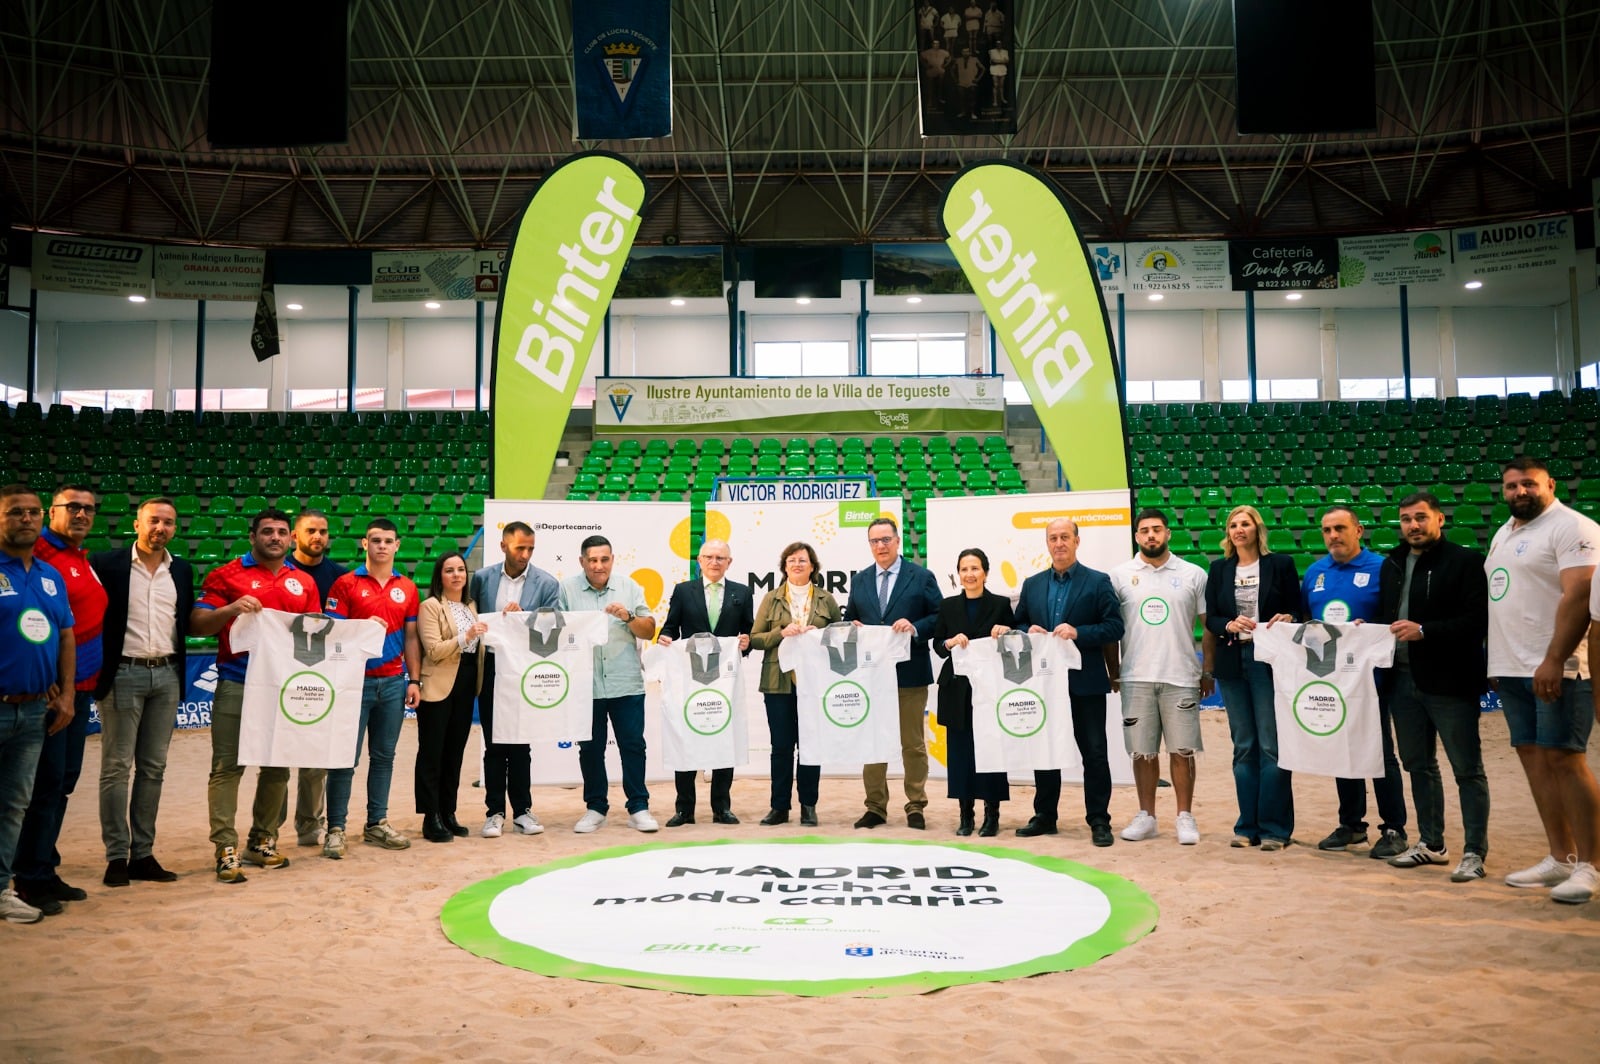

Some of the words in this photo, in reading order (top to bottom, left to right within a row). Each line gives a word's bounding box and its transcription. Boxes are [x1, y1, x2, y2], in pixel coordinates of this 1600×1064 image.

[606, 28, 630, 36] LUCHA
[630, 29, 658, 51] TEGUESTE
[1480, 219, 1568, 244] AUDIOTEC
[158, 252, 189, 261] Antonio
[234, 255, 264, 264] Barreto
[1252, 246, 1313, 259] Cafetería
[183, 264, 220, 273] GRANJA
[377, 266, 420, 274] CLUB
[1242, 260, 1289, 278] Donde
[1292, 260, 1325, 276] Poli
[514, 176, 636, 394] Binter
[647, 384, 690, 399] Ilustre
[695, 384, 792, 402] Ayuntamiento
[796, 384, 812, 398] de
[816, 384, 829, 398] la
[833, 383, 863, 398] Villa
[867, 383, 883, 398] de
[887, 383, 950, 402] Tegueste
[728, 485, 776, 502] VICTOR
[783, 483, 861, 500] RODRIGUEZ
[844, 511, 874, 521] Binter
[535, 523, 602, 532] @Deportecanario
[835, 692, 860, 700] MADRID
[1308, 695, 1335, 703] MADRID
[1008, 700, 1036, 708] MADRID
[668, 865, 989, 880] MADRID
[761, 881, 911, 893] lucha
[931, 885, 998, 893] en
[593, 890, 761, 906] modo
[780, 894, 1004, 907] canario
